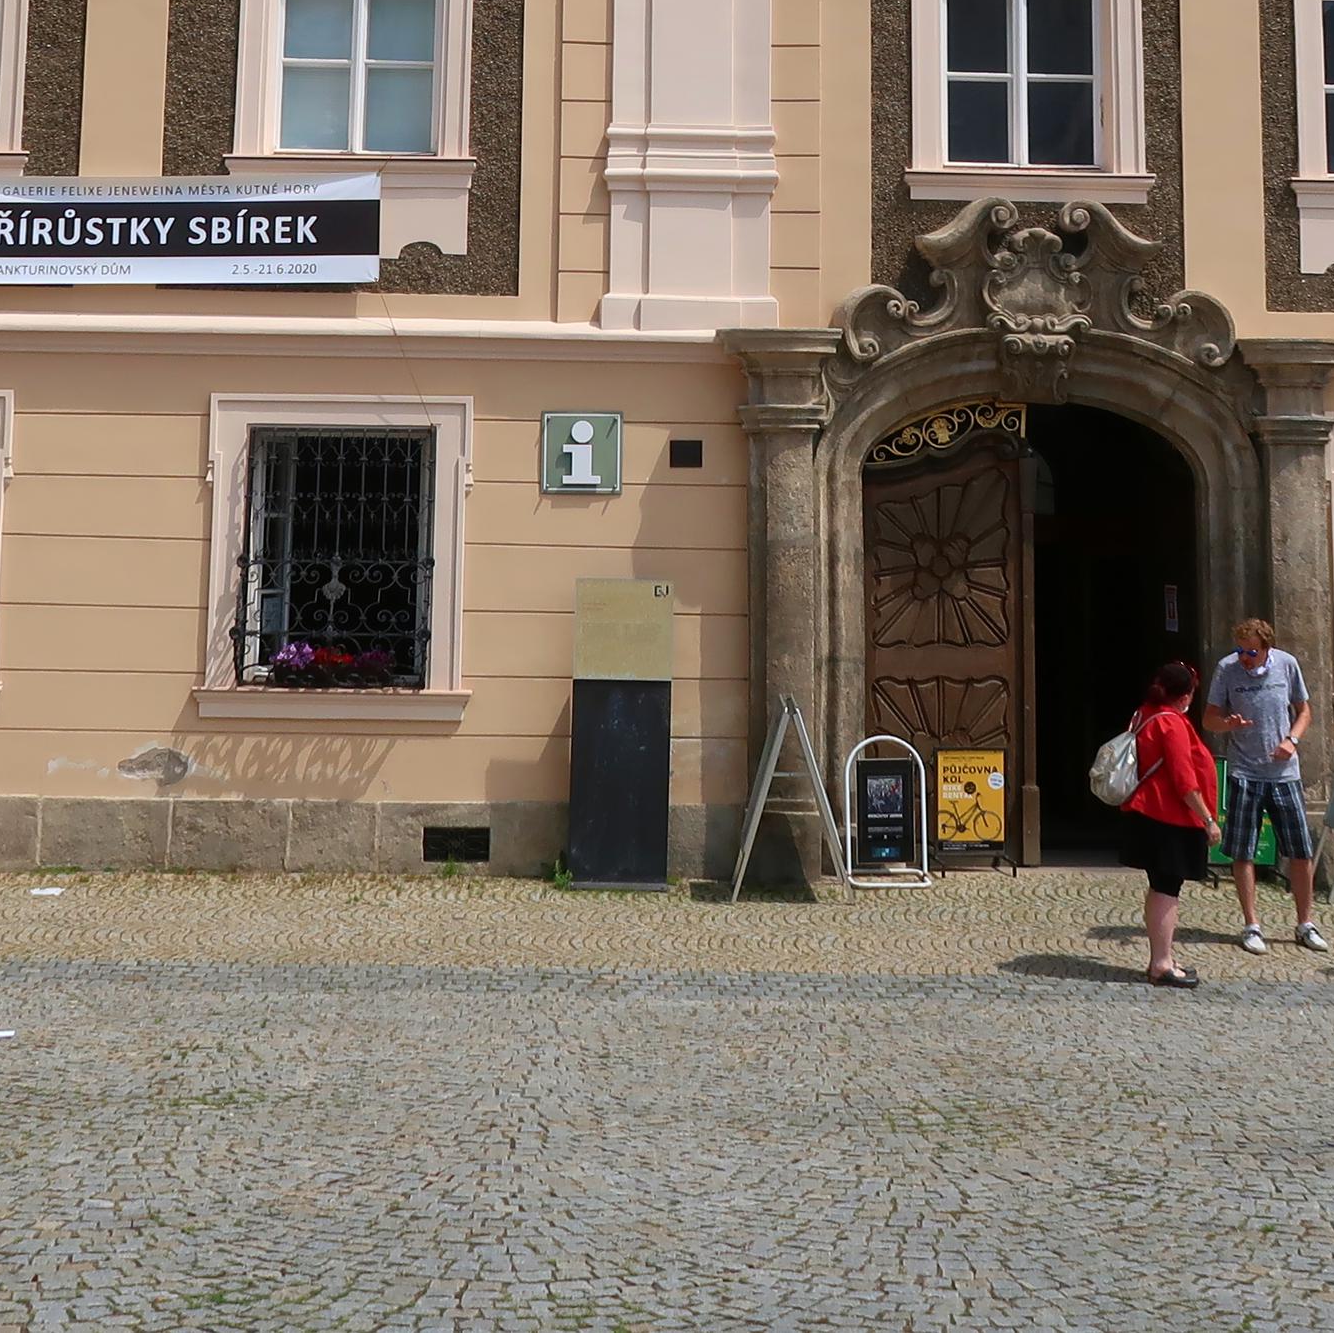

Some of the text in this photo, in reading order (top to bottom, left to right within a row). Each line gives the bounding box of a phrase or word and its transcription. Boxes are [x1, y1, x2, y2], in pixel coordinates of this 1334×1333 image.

[2, 185, 56, 197] GALERIE
[61, 185, 103, 197] FELIXE
[107, 184, 184, 197] JENEWEINA
[187, 182, 231, 196] MĚSTA
[236, 182, 278, 196] KUTNÉ
[283, 184, 319, 195] HORY
[187, 208, 318, 245] SBÍREK
[100, 261, 132, 276] DŮM
[231, 263, 317, 276] 2.5.-21.6.2020
[942, 763, 998, 775] PŮJČOVNA
[942, 775, 964, 784] KOL
